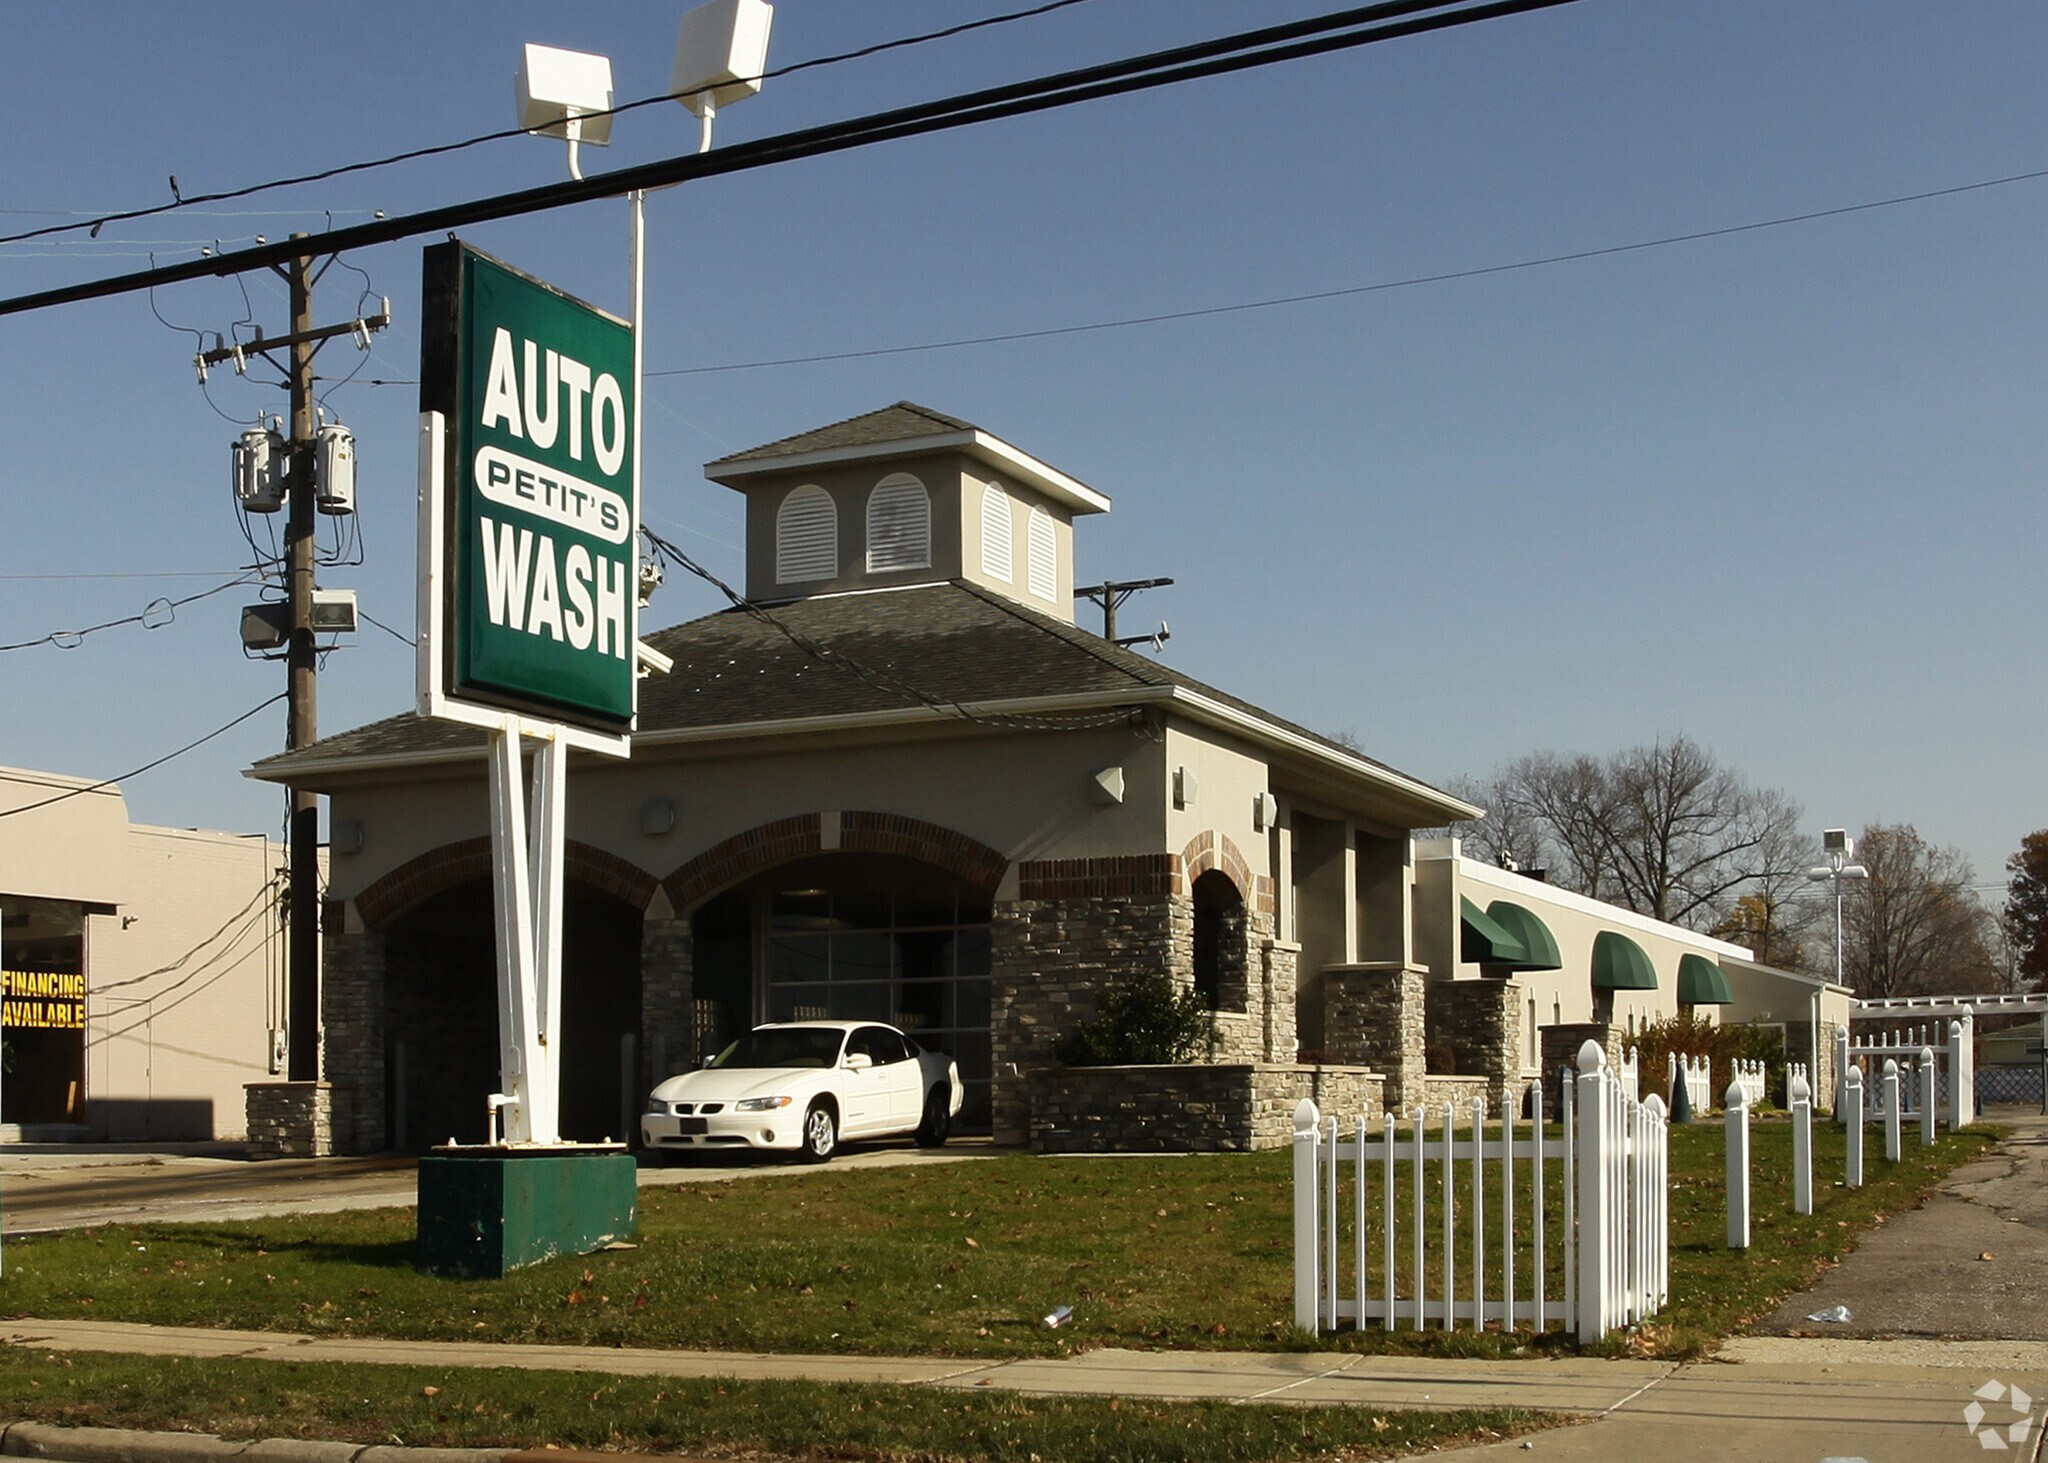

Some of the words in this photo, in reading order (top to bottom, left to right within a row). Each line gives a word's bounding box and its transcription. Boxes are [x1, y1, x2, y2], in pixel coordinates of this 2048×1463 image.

[481, 326, 627, 477] AUTO
[487, 458, 619, 531] PETIT'S
[480, 515, 626, 661] WASH
[1, 970, 85, 1000] FINANCING
[1, 1001, 85, 1029] AVAILABLE
